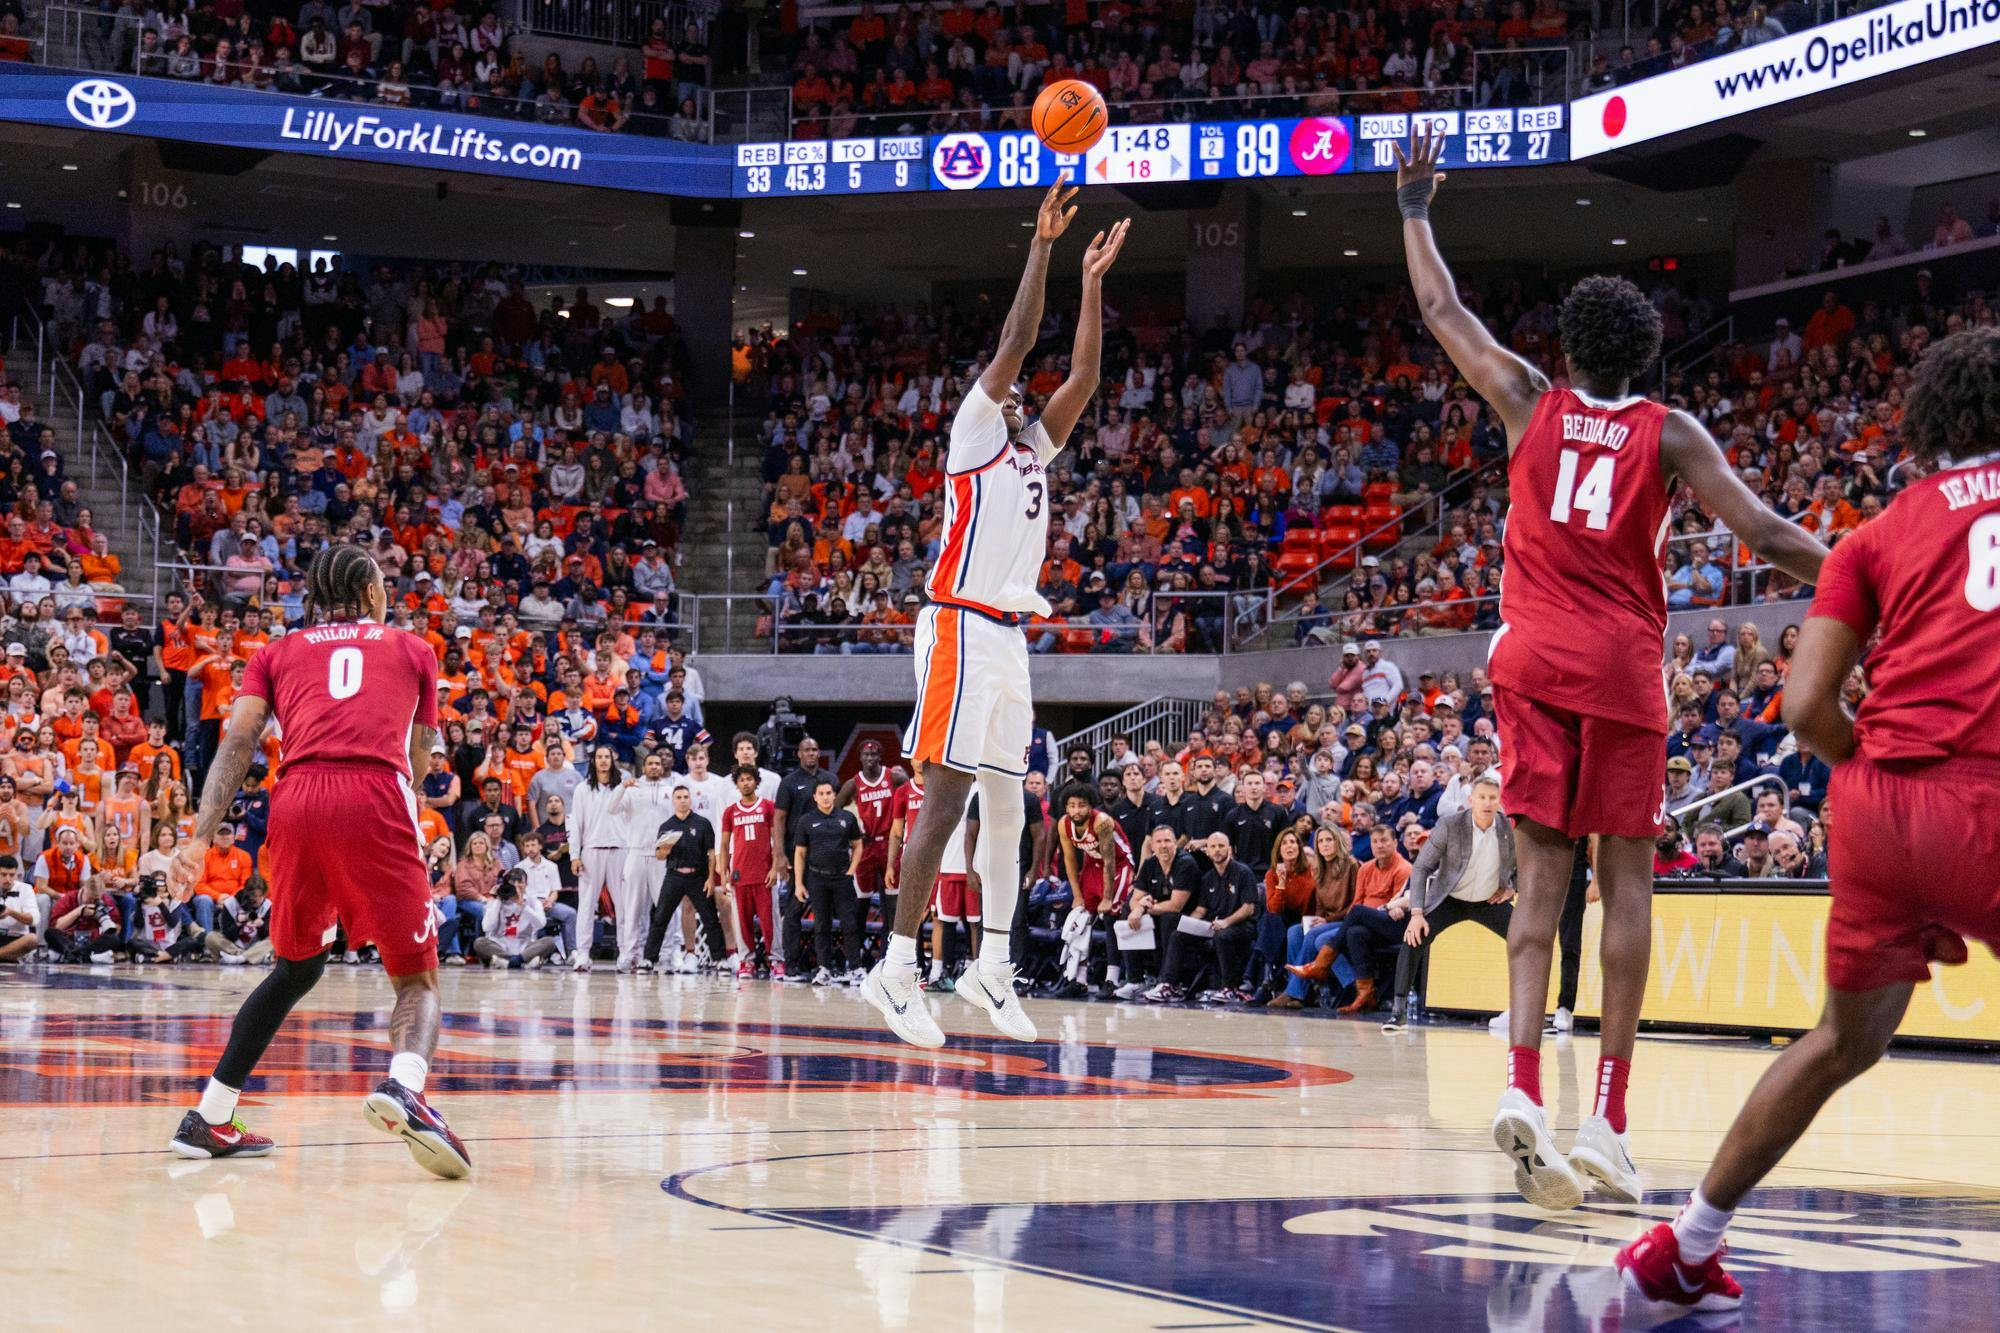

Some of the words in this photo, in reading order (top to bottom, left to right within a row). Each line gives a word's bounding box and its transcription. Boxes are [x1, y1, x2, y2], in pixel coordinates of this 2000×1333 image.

[1200, 126, 1224, 137] TOL
[1362, 119, 1405, 135] FOULS
[1522, 111, 1556, 128] REB
[280, 107, 582, 170] LillyForkLifts.com
[842, 144, 866, 158] TO
[882, 141, 920, 157] FOULS
[1110, 127, 1170, 153] 1:48
[1208, 140, 1215, 156] 2
[1236, 123, 1280, 177] 89
[1466, 134, 1511, 163] 55.2
[1527, 131, 1551, 161] 27
[743, 149, 776, 163] REB
[998, 135, 1040, 187] 83
[1373, 139, 1394, 167] 10
[747, 166, 771, 193] 33
[785, 163, 826, 191] 45.3
[848, 162, 861, 189] 5
[895, 160, 909, 187] 9
[1127, 160, 1151, 178] 18
[140, 181, 189, 209] 106
[1193, 222, 1239, 247] 105
[1562, 414, 1629, 451] BEDIAKO
[1025, 481, 1043, 520] 3
[1550, 448, 1616, 531] 14
[1964, 511, 2000, 612] 6
[303, 628, 360, 645] PHILON
[363, 628, 384, 641] JR.
[328, 647, 364, 700] 0
[860, 788, 893, 803] ALABAMA
[873, 799, 882, 817] 7
[733, 814, 764, 826] ALABAMA
[744, 824, 756, 841] 11
[1653, 915, 1823, 1014] WIN
